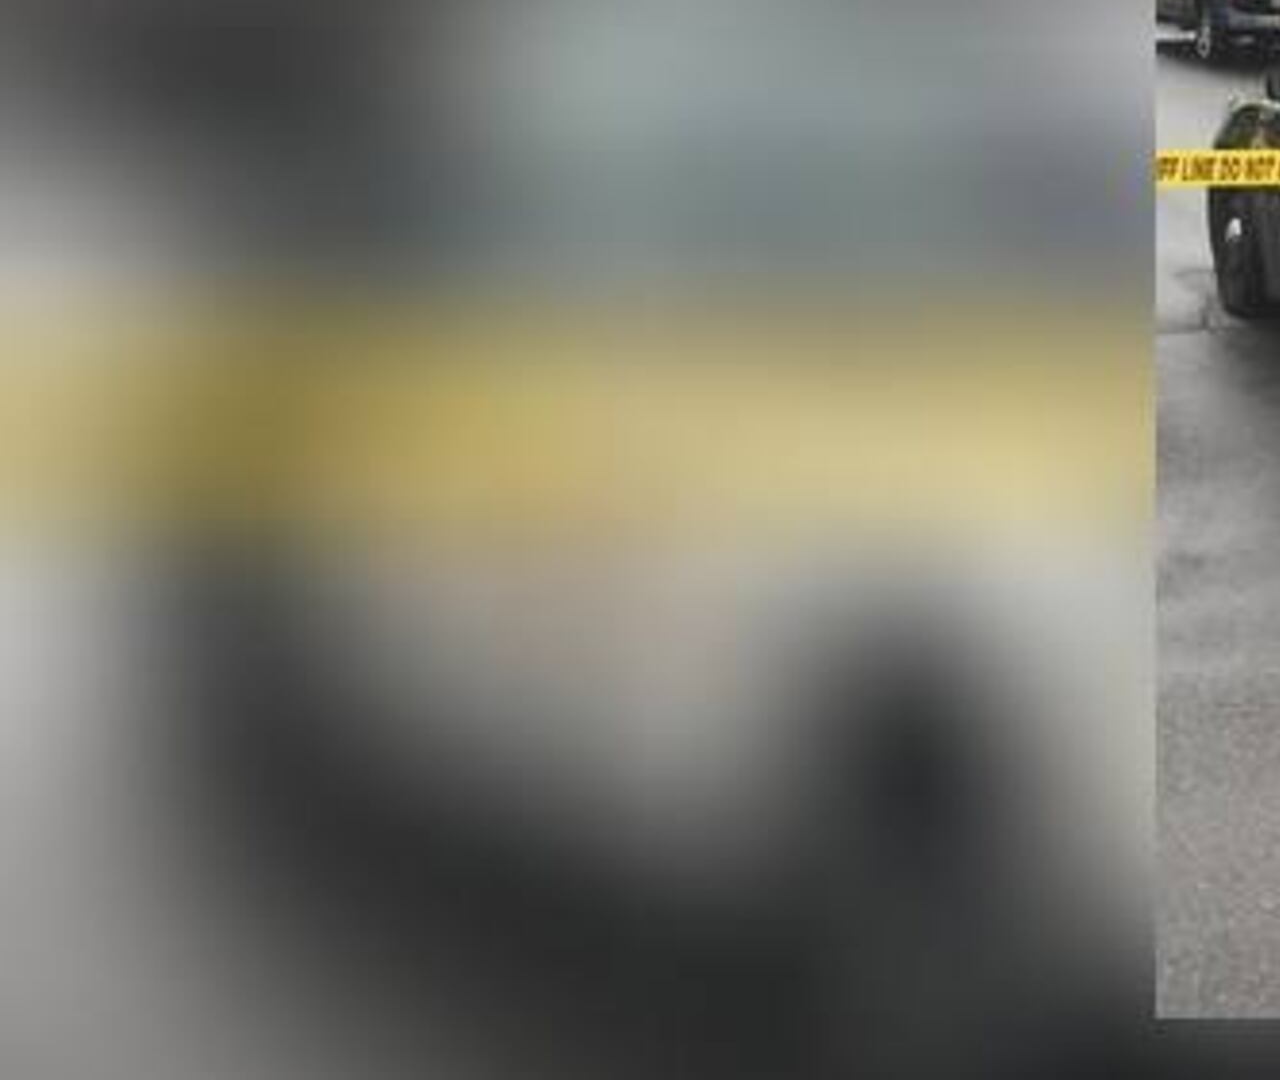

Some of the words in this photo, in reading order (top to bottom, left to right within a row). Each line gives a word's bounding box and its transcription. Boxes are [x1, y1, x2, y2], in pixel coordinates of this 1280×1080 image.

[1182, 156, 1216, 182] LINE
[1219, 156, 1242, 181] DO
[1245, 155, 1277, 180] NOT
